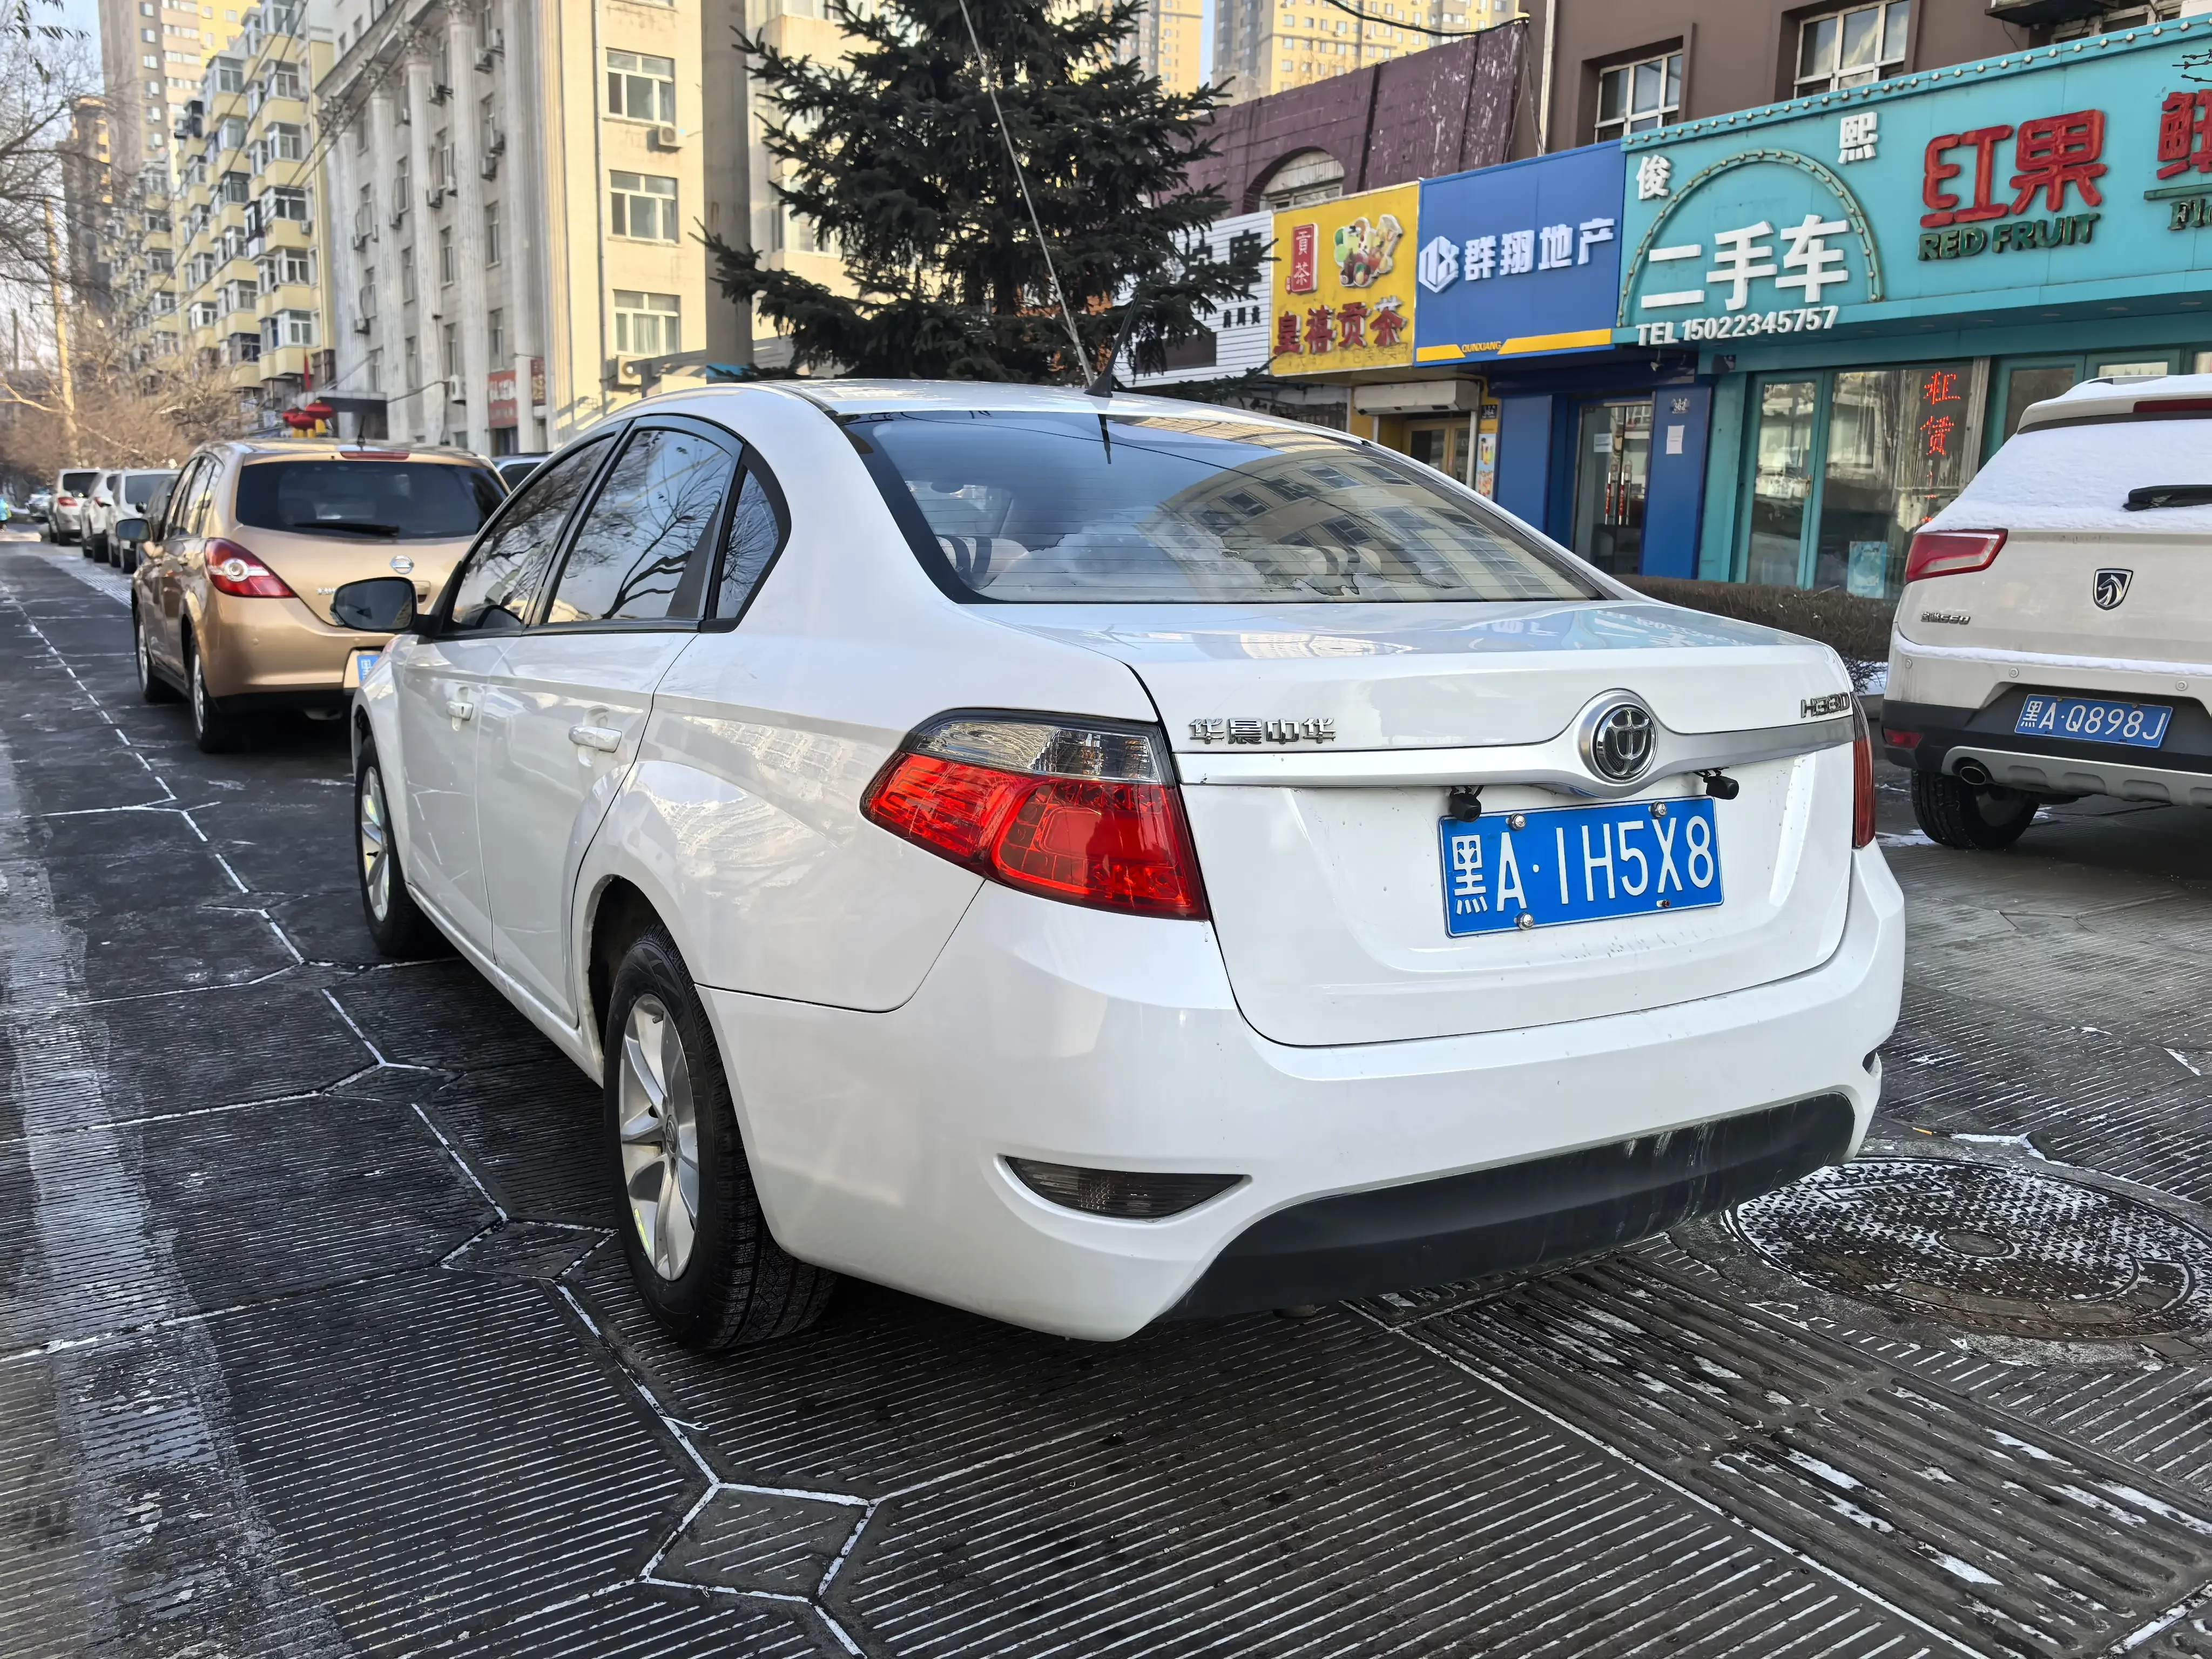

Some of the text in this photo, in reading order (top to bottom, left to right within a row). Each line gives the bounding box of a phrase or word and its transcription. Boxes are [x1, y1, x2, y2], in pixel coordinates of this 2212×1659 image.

[1636, 112, 1878, 200] 俊 熙
[1920, 109, 2108, 228] 红果
[1294, 231, 1312, 286] 貢茶
[1464, 218, 1615, 281] 群翔地产
[1641, 214, 1849, 311] 二手车
[1918, 213, 2101, 261] RED FRUIT
[1273, 295, 1408, 355] 皇禧贡茶
[1635, 305, 1838, 346] TEL 15022345757
[1919, 370, 1961, 456] 租赁
[1189, 717, 1337, 745] 华晨中华
